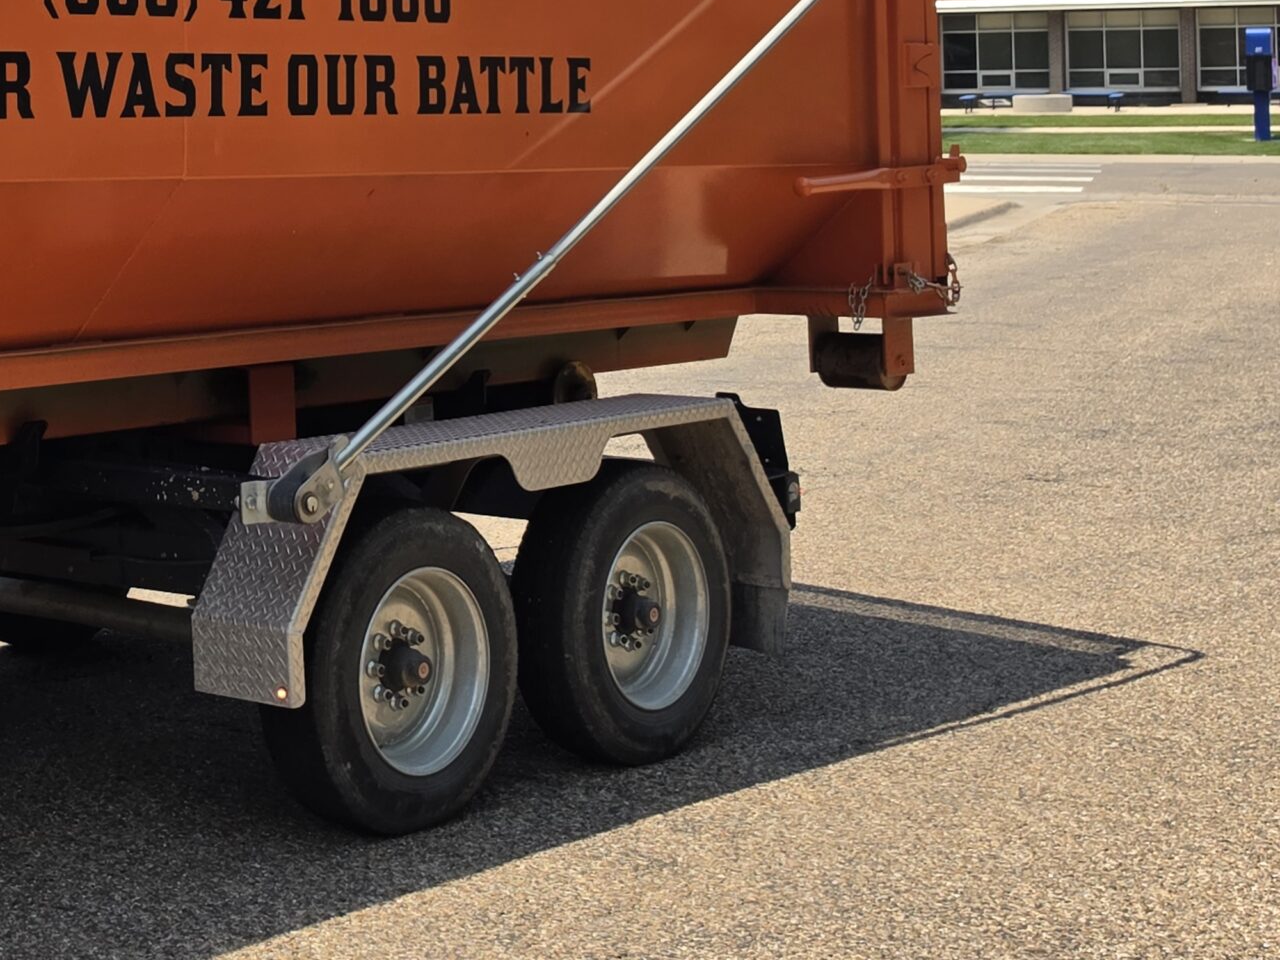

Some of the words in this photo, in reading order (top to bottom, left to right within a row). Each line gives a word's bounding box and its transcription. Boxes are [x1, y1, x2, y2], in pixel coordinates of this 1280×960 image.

[56, 51, 269, 120] WASTE
[287, 54, 399, 116] OUR
[416, 55, 592, 116] BATTLE
